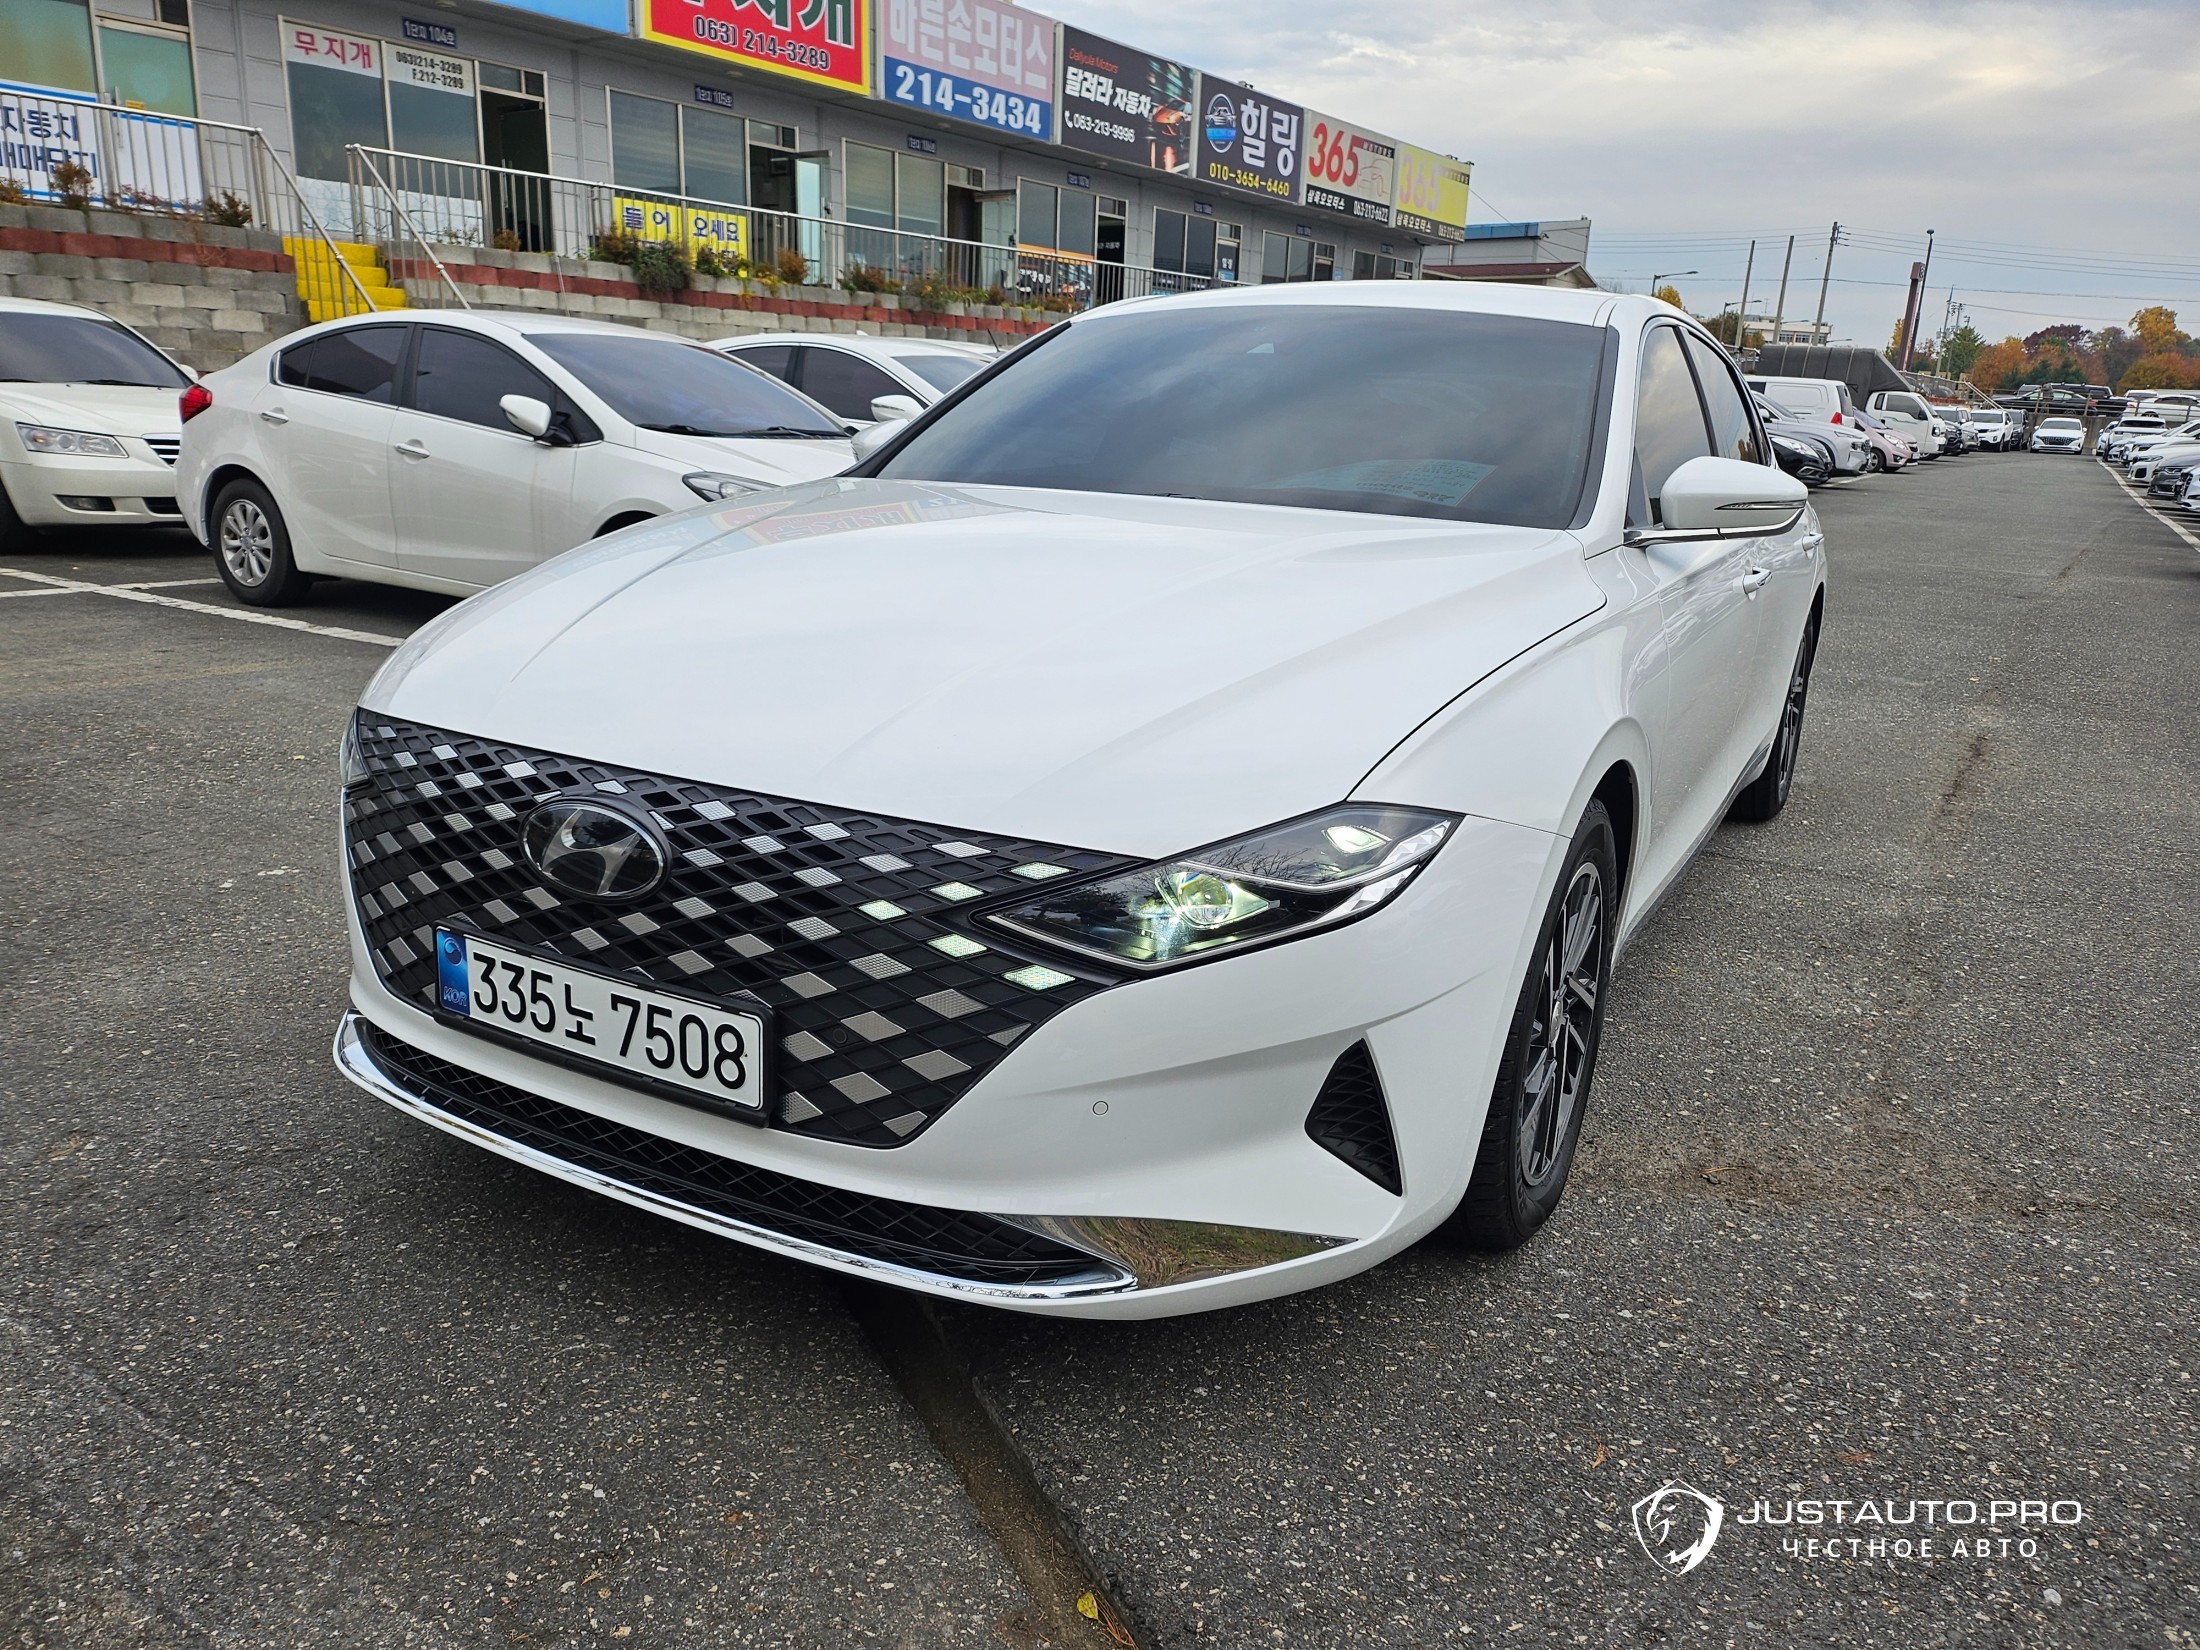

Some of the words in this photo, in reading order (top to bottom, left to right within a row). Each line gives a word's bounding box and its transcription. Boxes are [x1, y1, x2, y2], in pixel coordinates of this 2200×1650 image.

[294, 30, 373, 70] 무지개
[428, 25, 456, 46] 104호
[692, 15, 739, 47] 063)
[742, 29, 831, 71] 214-3289
[895, 64, 1042, 135] 214-3434
[1064, 65, 1114, 107] 달려라
[1112, 86, 1152, 119] 자동차
[0, 104, 79, 142] 자동차
[1073, 113, 1136, 143] 063-213-9996
[1239, 98, 1300, 178] 힐링
[1308, 121, 1359, 188] 365
[1363, 140, 1393, 158] MOTORS
[1209, 162, 1290, 197] 010-3654-6460
[1399, 151, 1439, 214] 365
[1307, 189, 1346, 211] 삼육오모터스
[692, 216, 740, 242] 오세요
[1396, 211, 1432, 233] 삼육오모터스
[443, 985, 467, 1008] KOR
[472, 950, 597, 1047] 335노
[610, 992, 747, 1091] 7508
